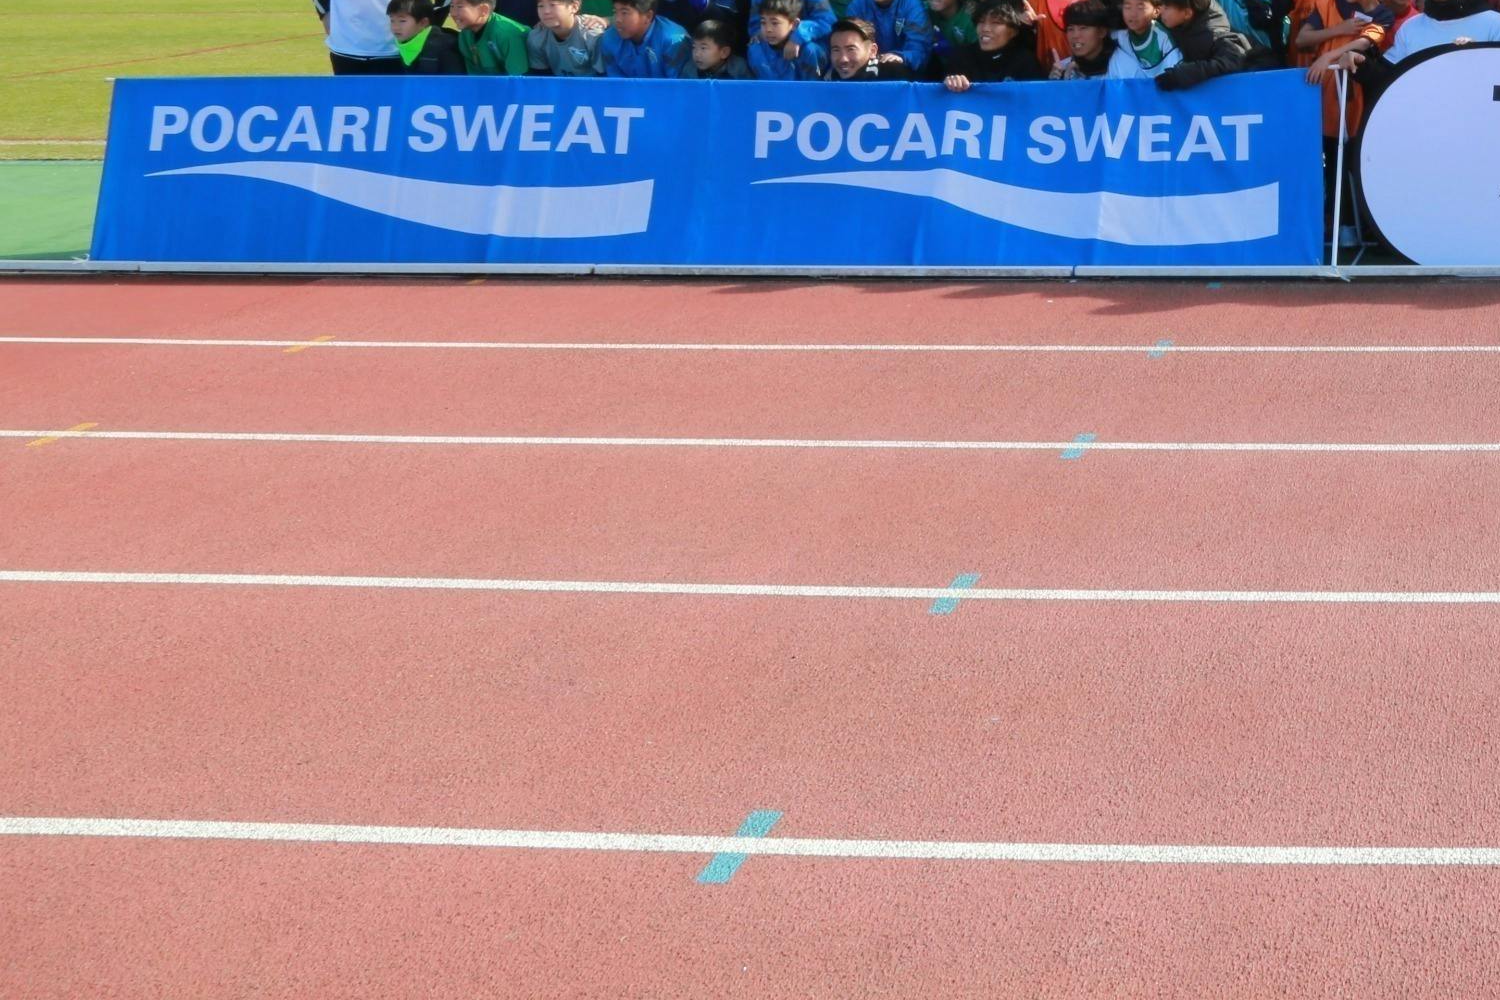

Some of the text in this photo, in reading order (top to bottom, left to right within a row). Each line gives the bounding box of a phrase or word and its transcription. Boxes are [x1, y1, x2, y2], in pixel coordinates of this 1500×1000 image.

[148, 103, 645, 155] POCARI SWEAT
[753, 109, 1263, 165] POCARI SWEAT
